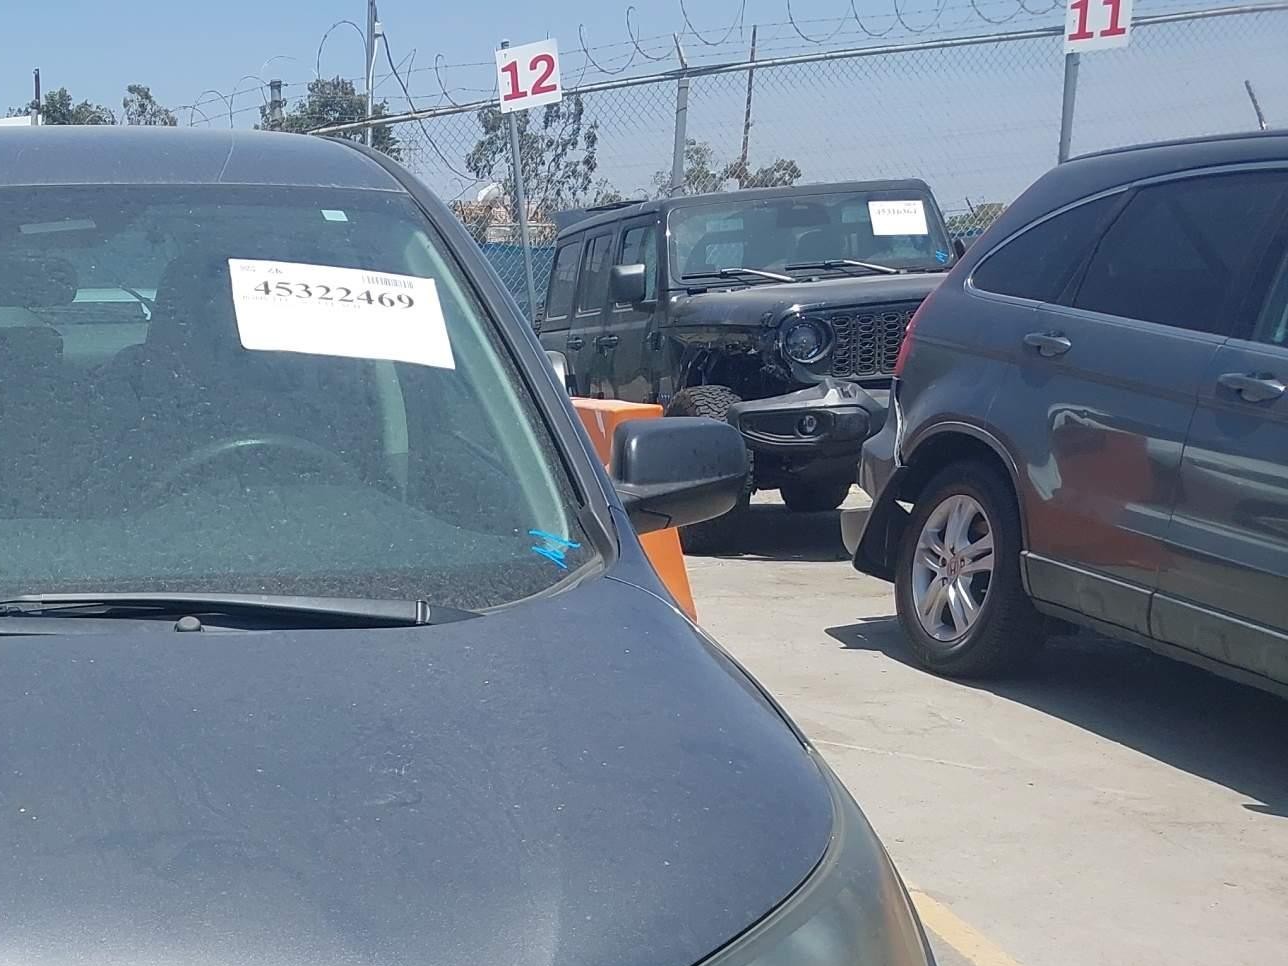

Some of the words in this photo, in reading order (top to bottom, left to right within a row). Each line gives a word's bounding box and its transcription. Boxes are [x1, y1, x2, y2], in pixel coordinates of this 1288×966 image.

[1068, 0, 1126, 41] 11
[501, 53, 557, 101] 12
[254, 280, 415, 310] 45322469
